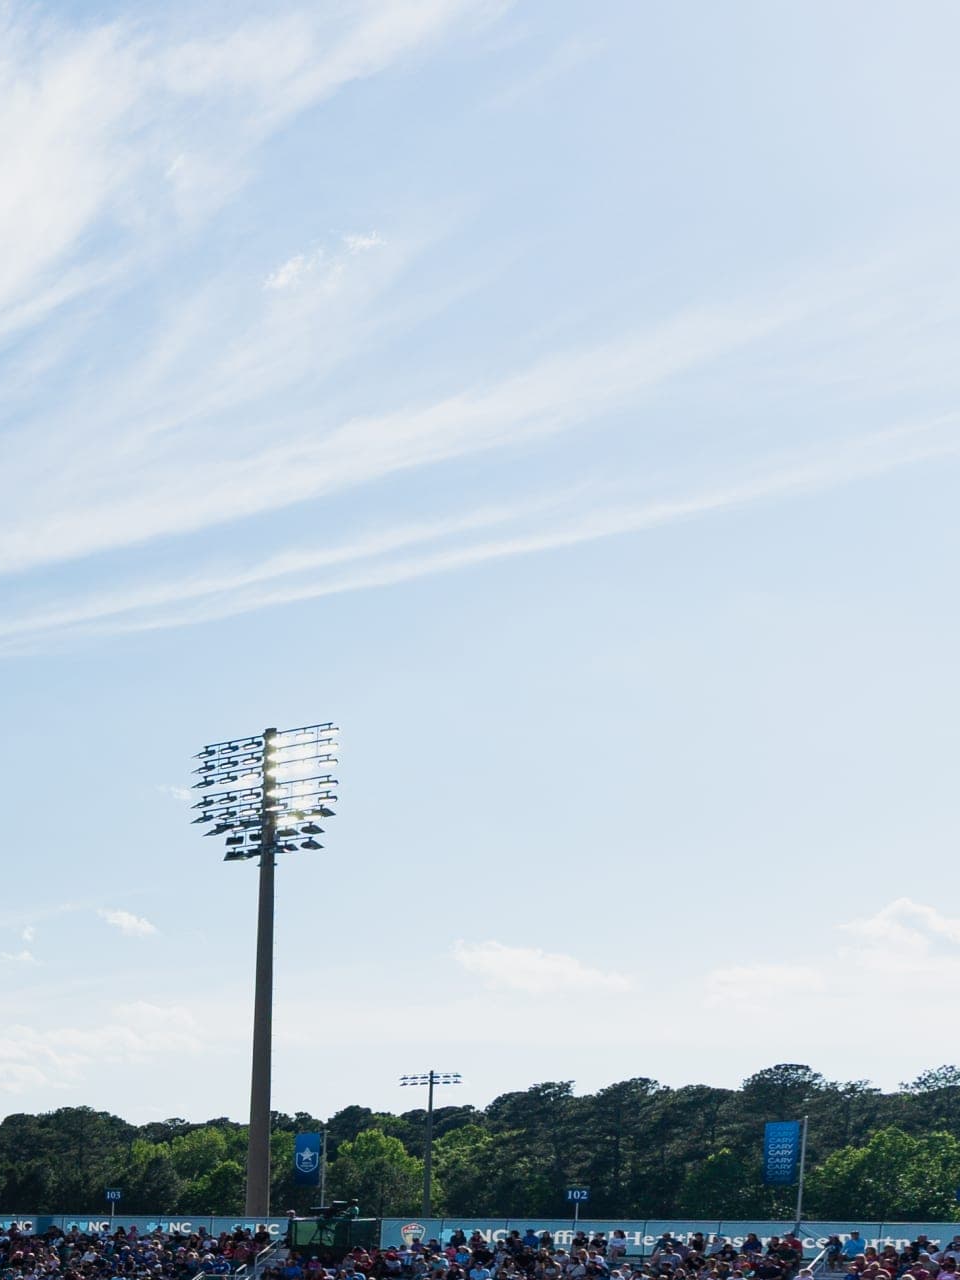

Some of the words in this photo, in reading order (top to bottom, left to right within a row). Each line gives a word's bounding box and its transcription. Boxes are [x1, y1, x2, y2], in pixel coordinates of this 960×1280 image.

[106, 1191, 121, 1199] 103
[567, 1190, 588, 1200] 102
[169, 1222, 192, 1233] NC
